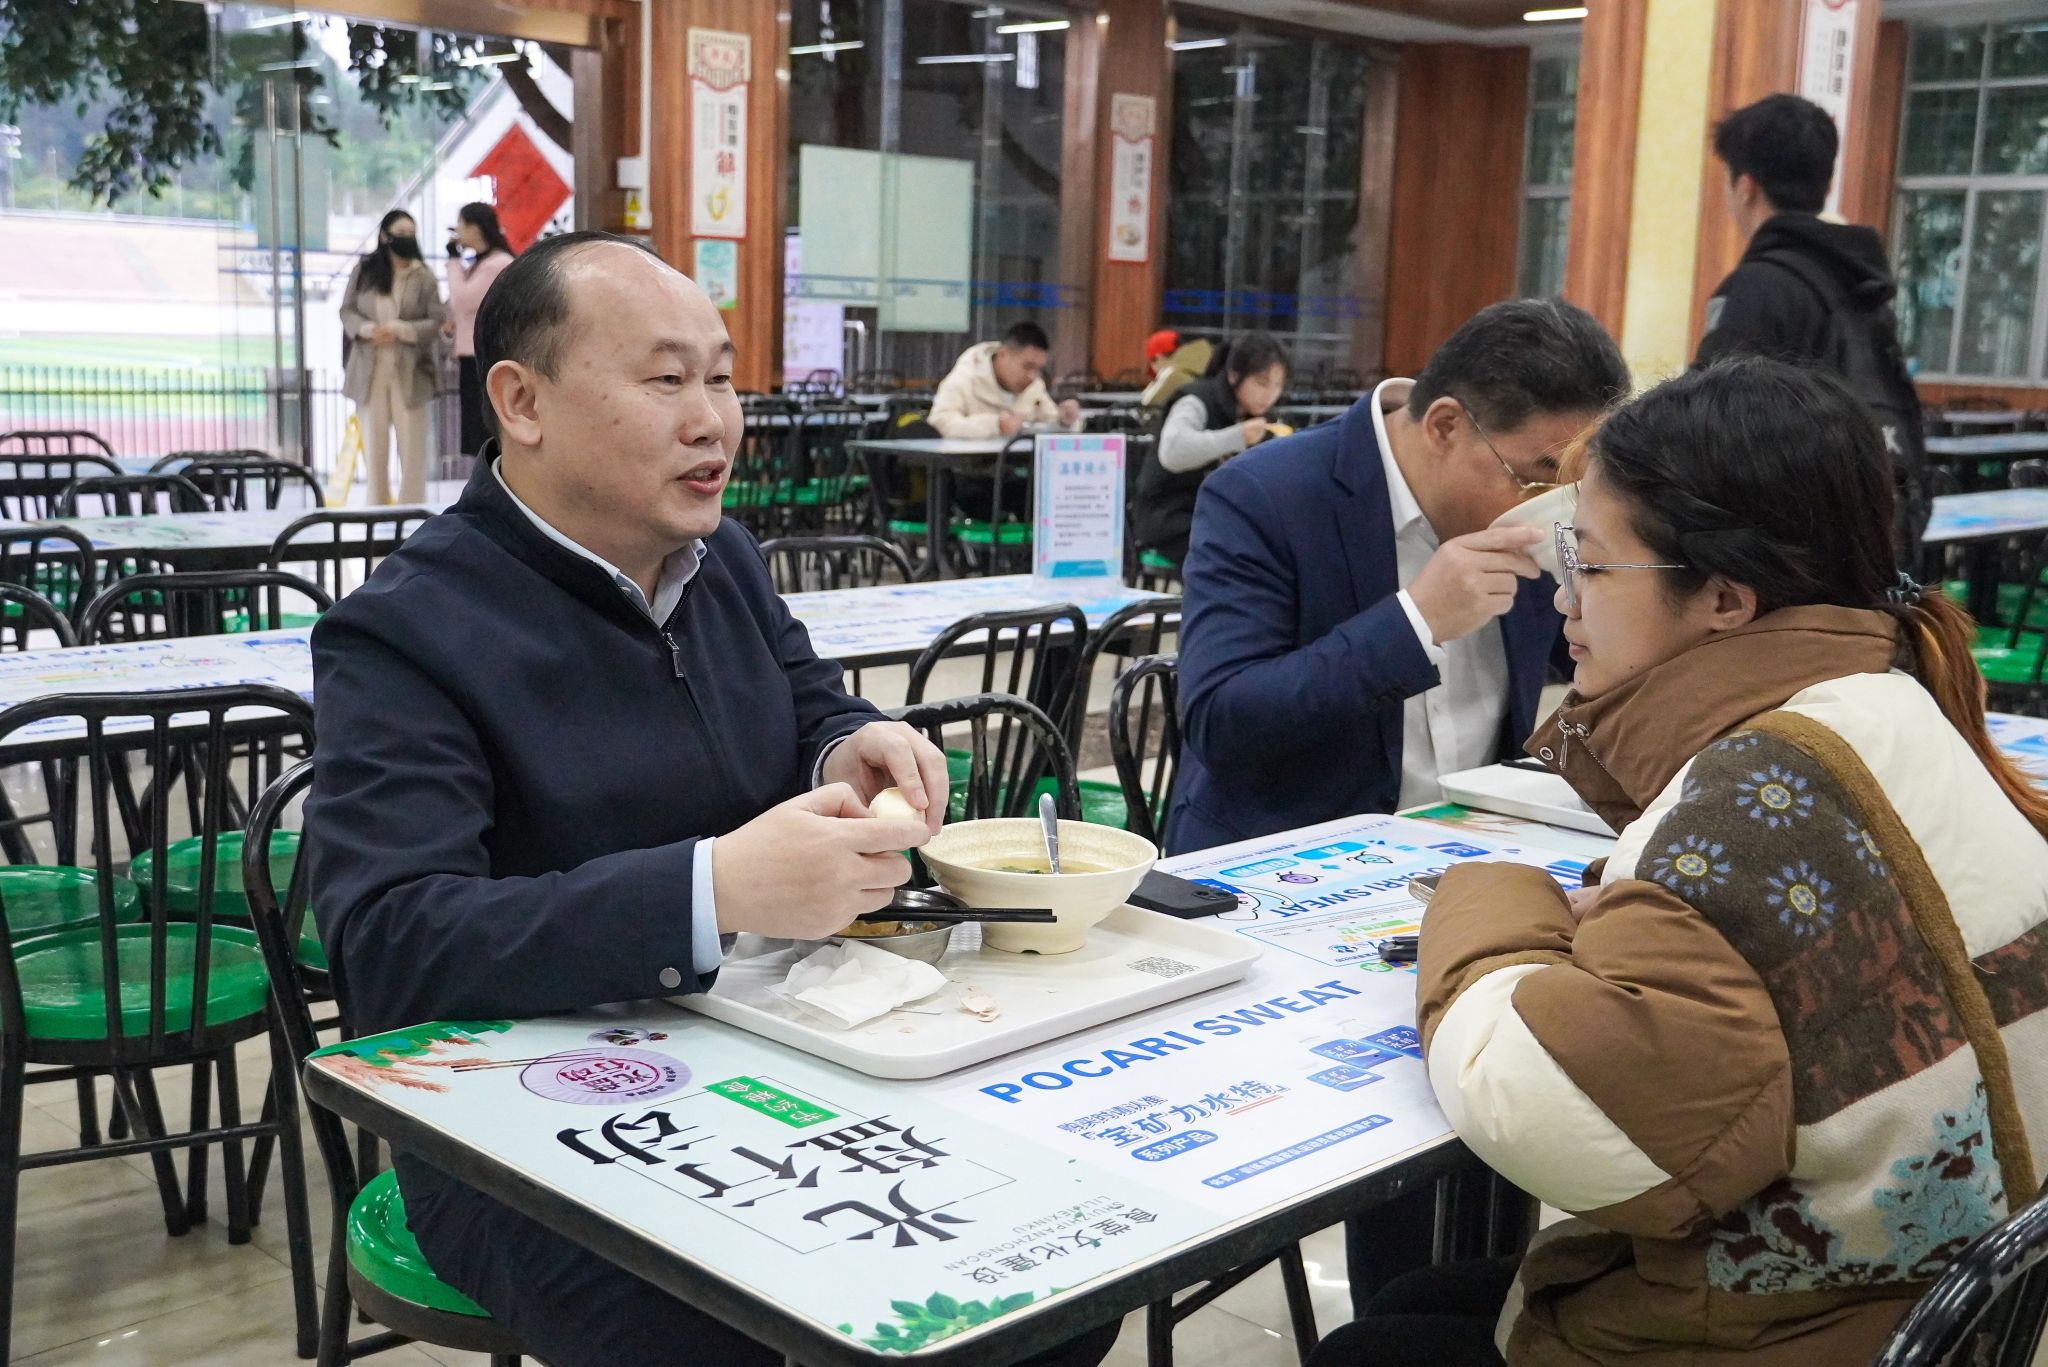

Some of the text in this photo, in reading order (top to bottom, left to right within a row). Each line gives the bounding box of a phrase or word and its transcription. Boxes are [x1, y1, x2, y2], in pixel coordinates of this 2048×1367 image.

[1268, 888, 1372, 918] SWEAT
[978, 979, 1363, 1104] POCARI SWEAT
[722, 1080, 823, 1123] 节约粮食
[1136, 1132, 1216, 1161] 系列产品
[960, 1206, 1159, 1285] 食堂文化建设
